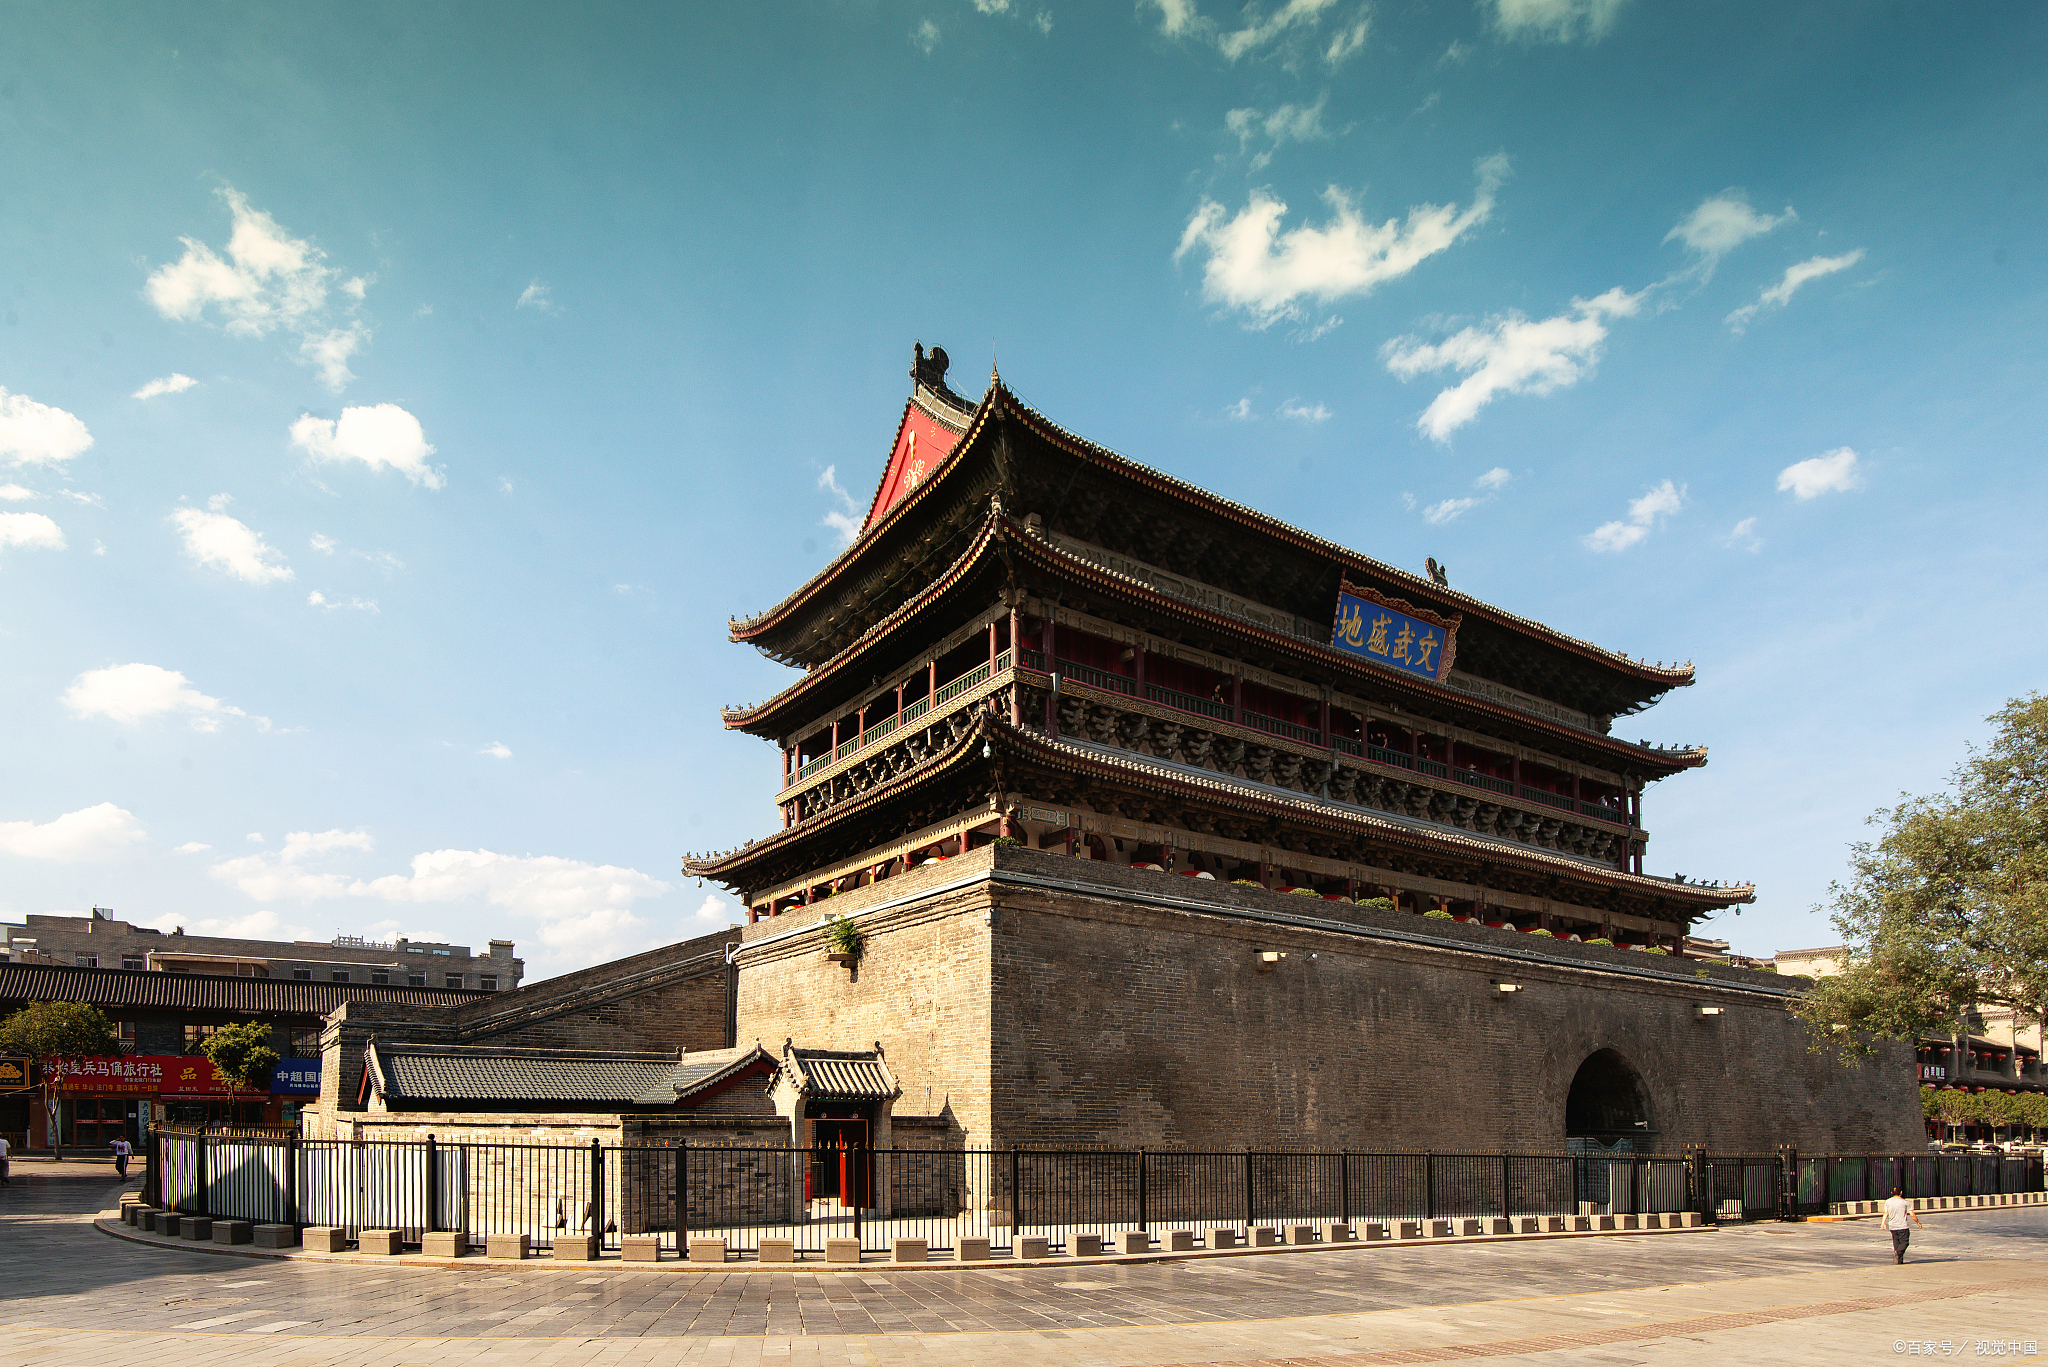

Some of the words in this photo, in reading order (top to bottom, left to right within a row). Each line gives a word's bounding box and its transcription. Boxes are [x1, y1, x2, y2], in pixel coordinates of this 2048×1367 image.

[42, 1060, 163, 1077] 秦始皇兵马俑旅行社
[82, 1083, 95, 1091] 华山
